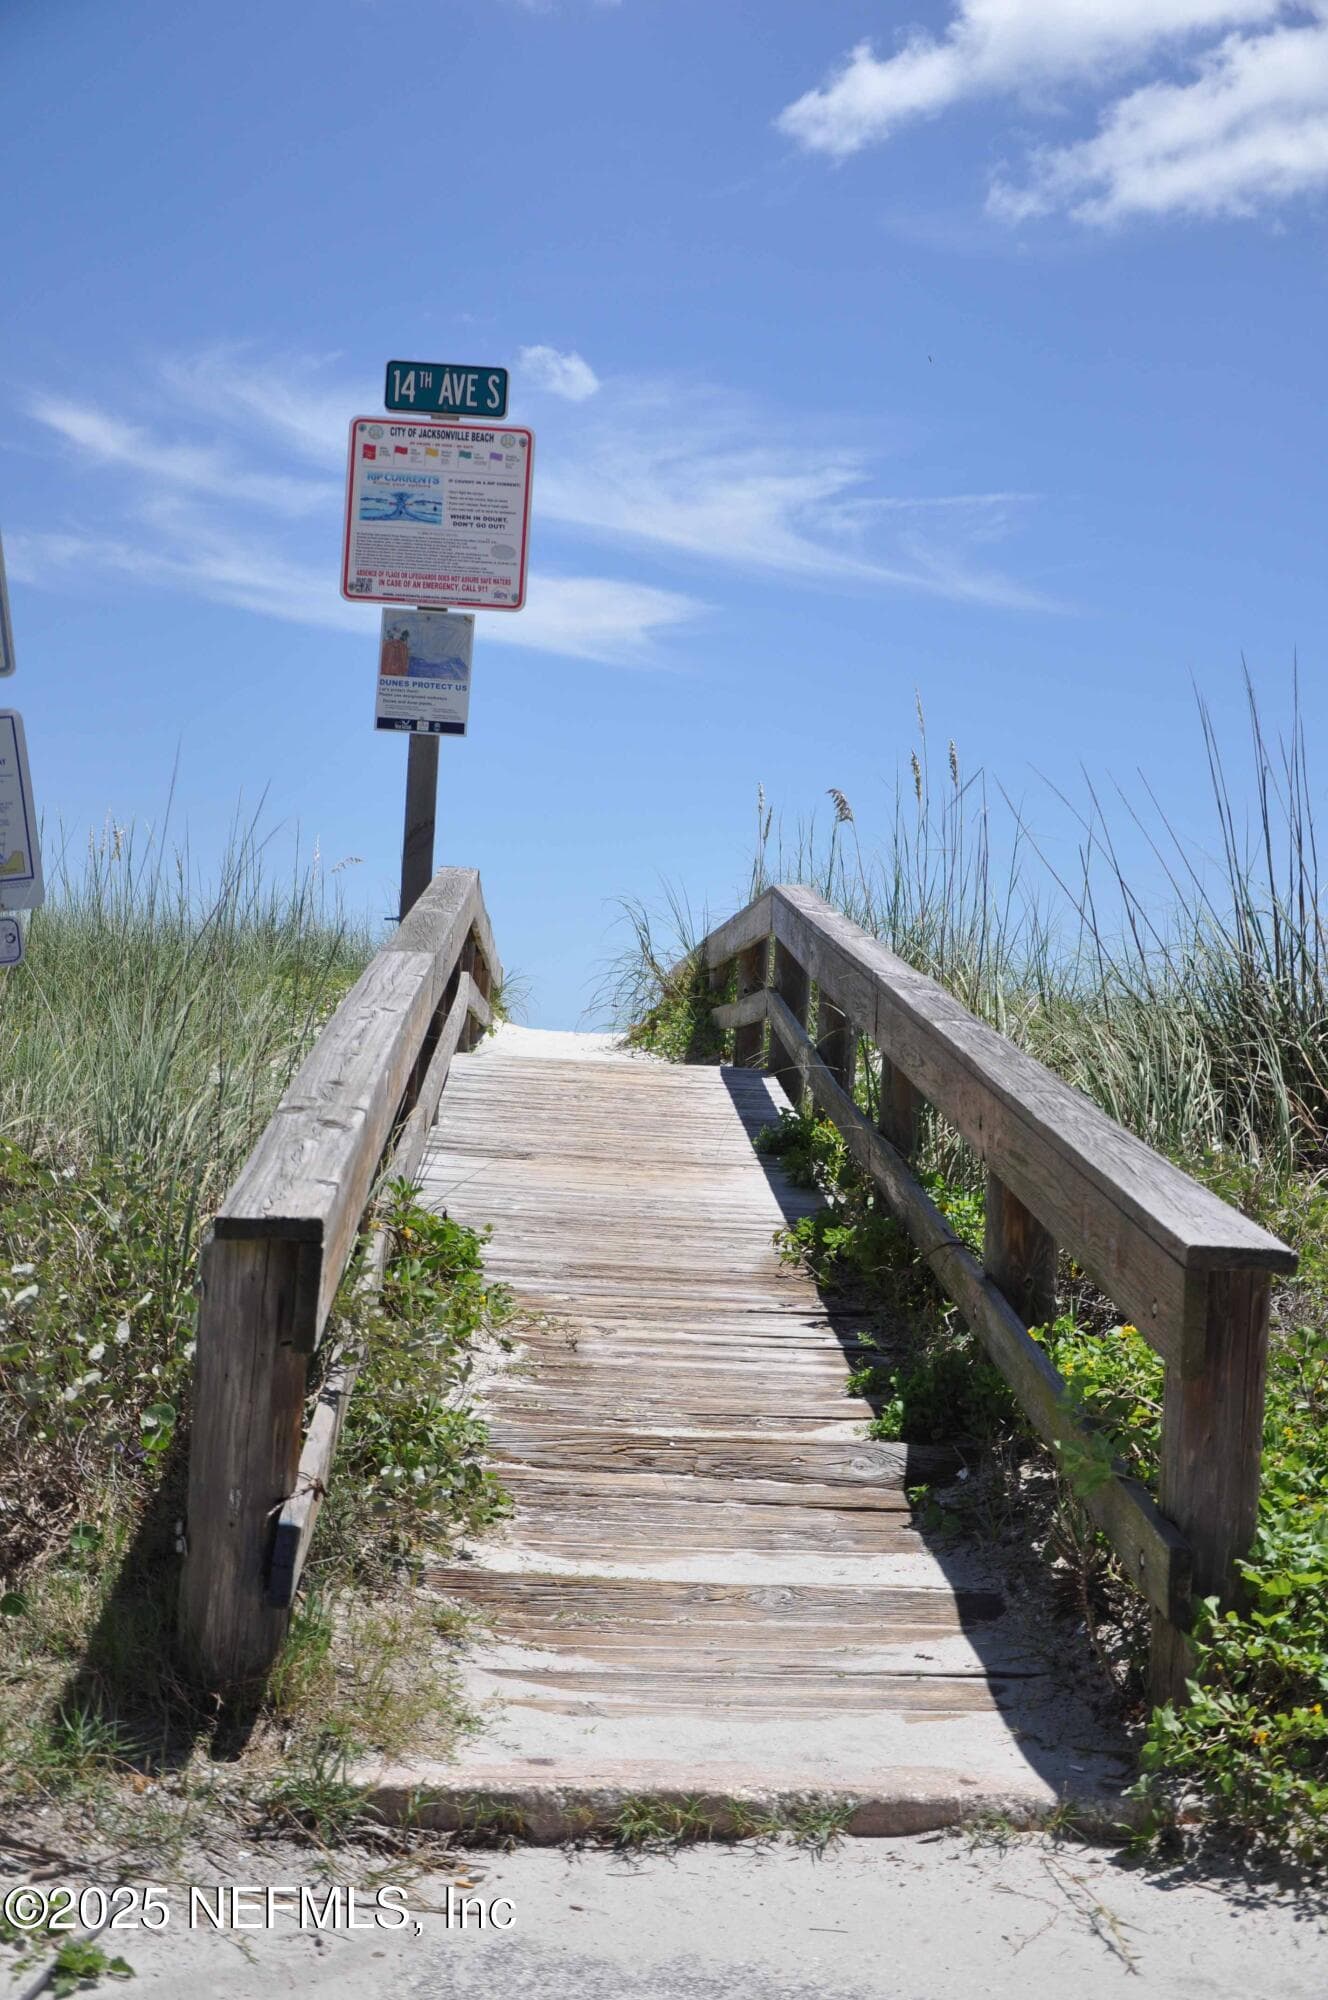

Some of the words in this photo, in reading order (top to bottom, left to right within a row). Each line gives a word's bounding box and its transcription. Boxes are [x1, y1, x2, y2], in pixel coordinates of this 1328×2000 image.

[393, 370, 433, 403] 14TH
[438, 373, 478, 407] AVE
[486, 375, 500, 409] S
[390, 427, 407, 437] CITY
[407, 428, 417, 438] OF
[418, 429, 470, 441] JACKSONVILLE
[471, 432, 495, 442] BEACH
[384, 473, 440, 484] CURRENTS
[422, 582, 460, 592] EMERGENCY,
[380, 679, 410, 688] DUNES
[412, 681, 453, 690] PROTECT
